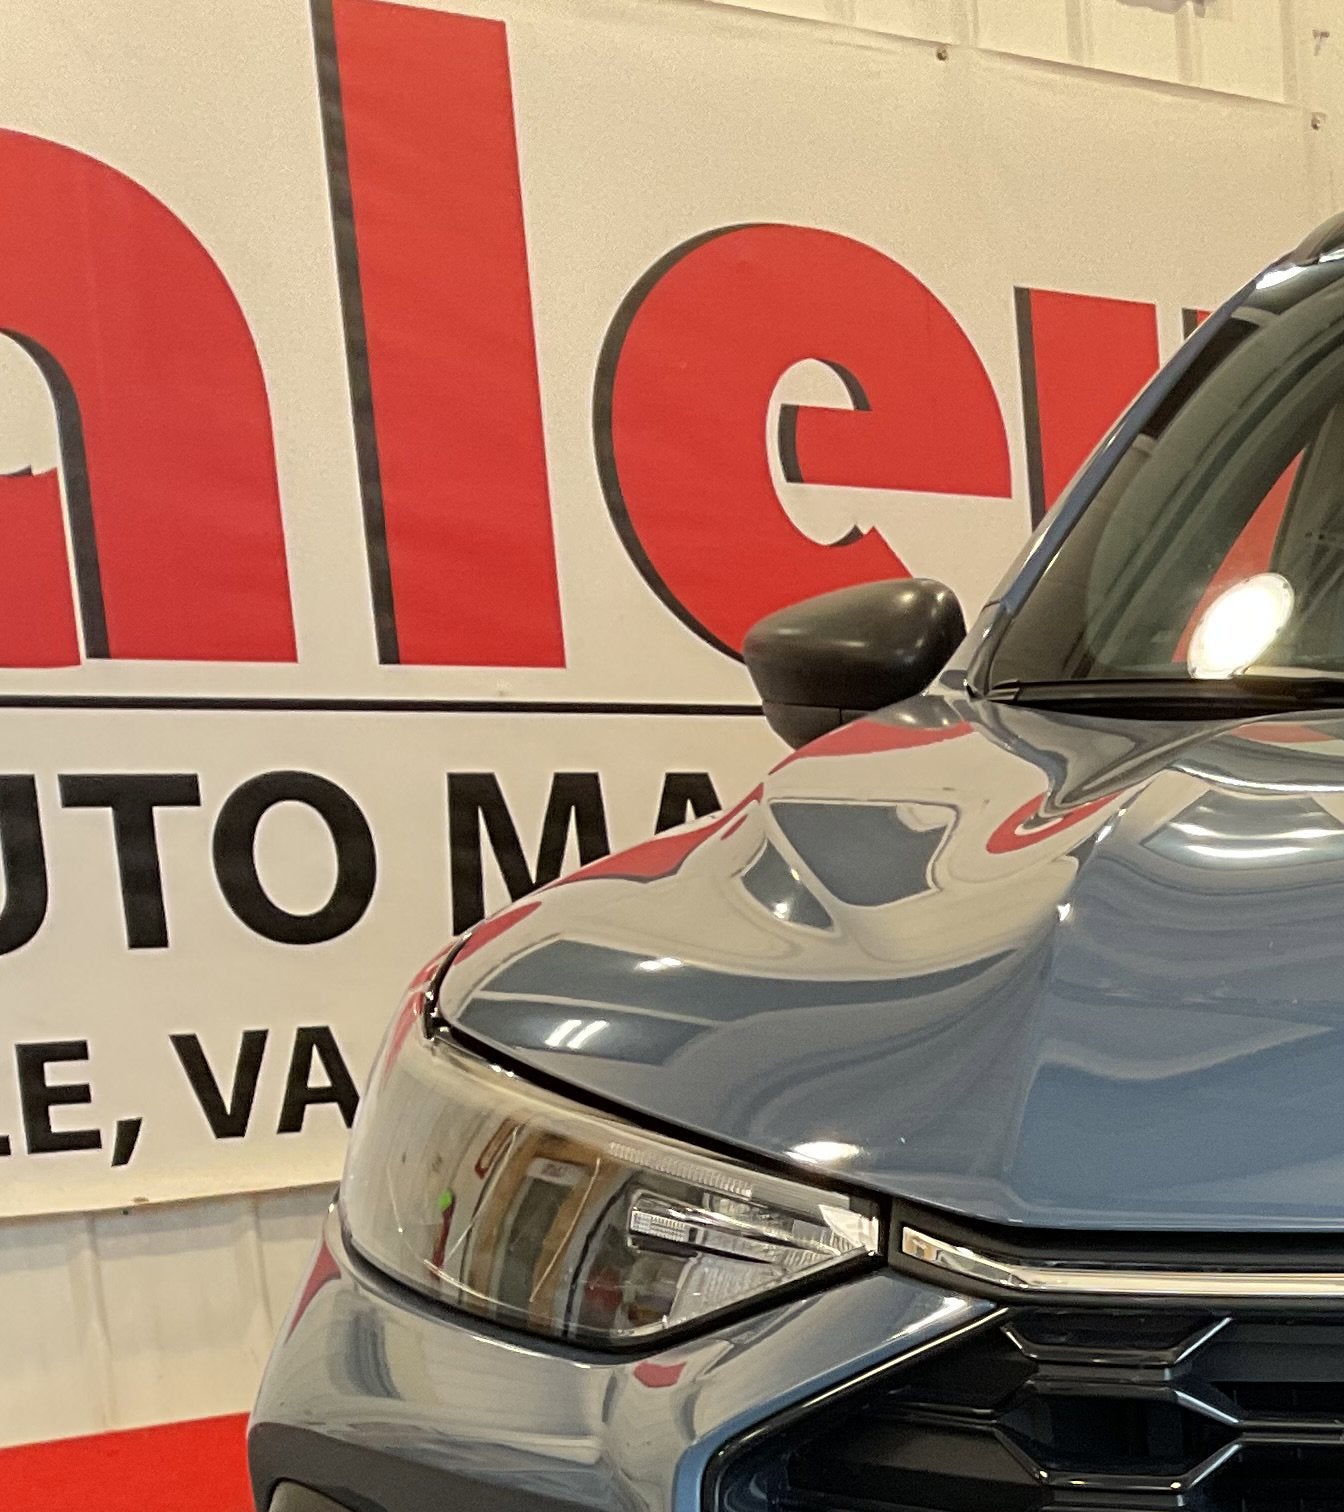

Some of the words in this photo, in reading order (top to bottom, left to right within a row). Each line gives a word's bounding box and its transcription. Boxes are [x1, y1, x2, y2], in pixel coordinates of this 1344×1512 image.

[0, 0, 1214, 668] ale
[446, 772, 722, 936] M
[0, 1038, 144, 1167] E,
[168, 1025, 361, 1140] VA
